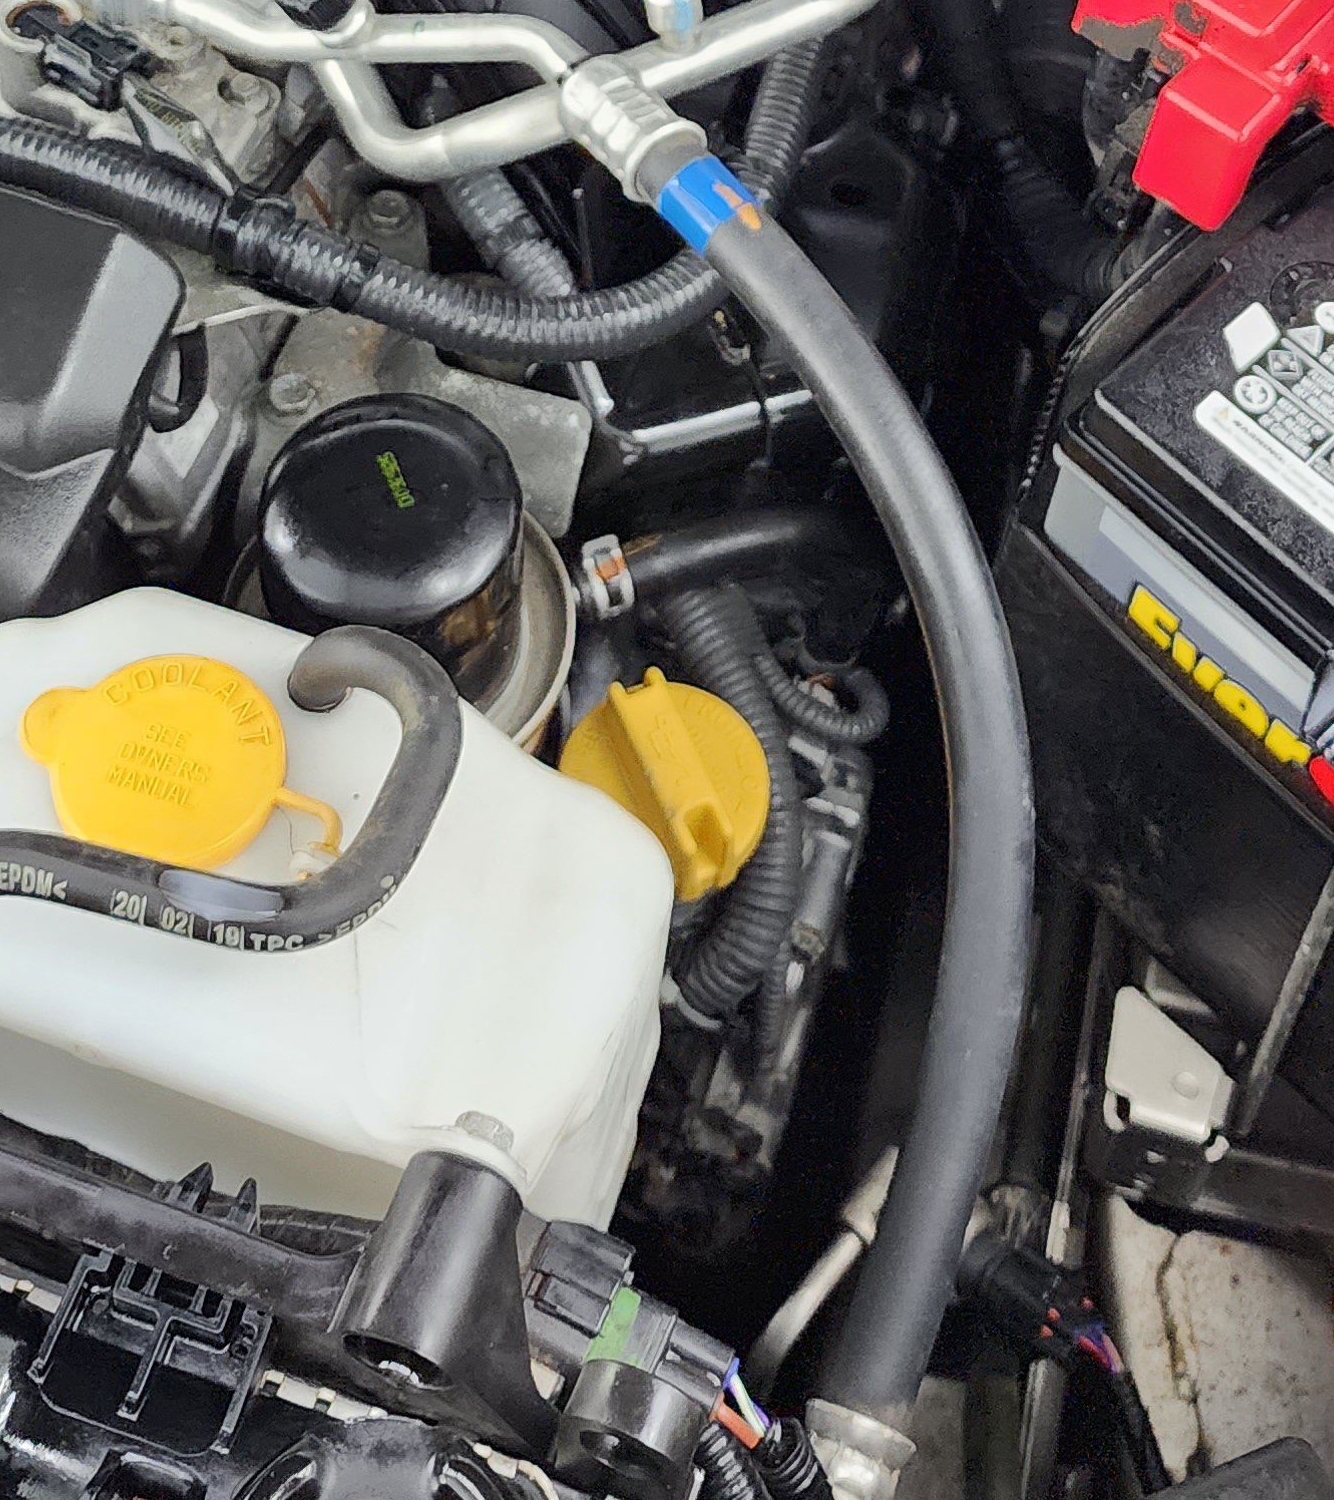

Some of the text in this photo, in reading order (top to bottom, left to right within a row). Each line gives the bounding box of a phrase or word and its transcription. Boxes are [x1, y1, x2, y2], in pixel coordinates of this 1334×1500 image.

[103, 661, 272, 747] COOLANT
[143, 722, 187, 750] SEE
[107, 763, 193, 807] MANUAL
